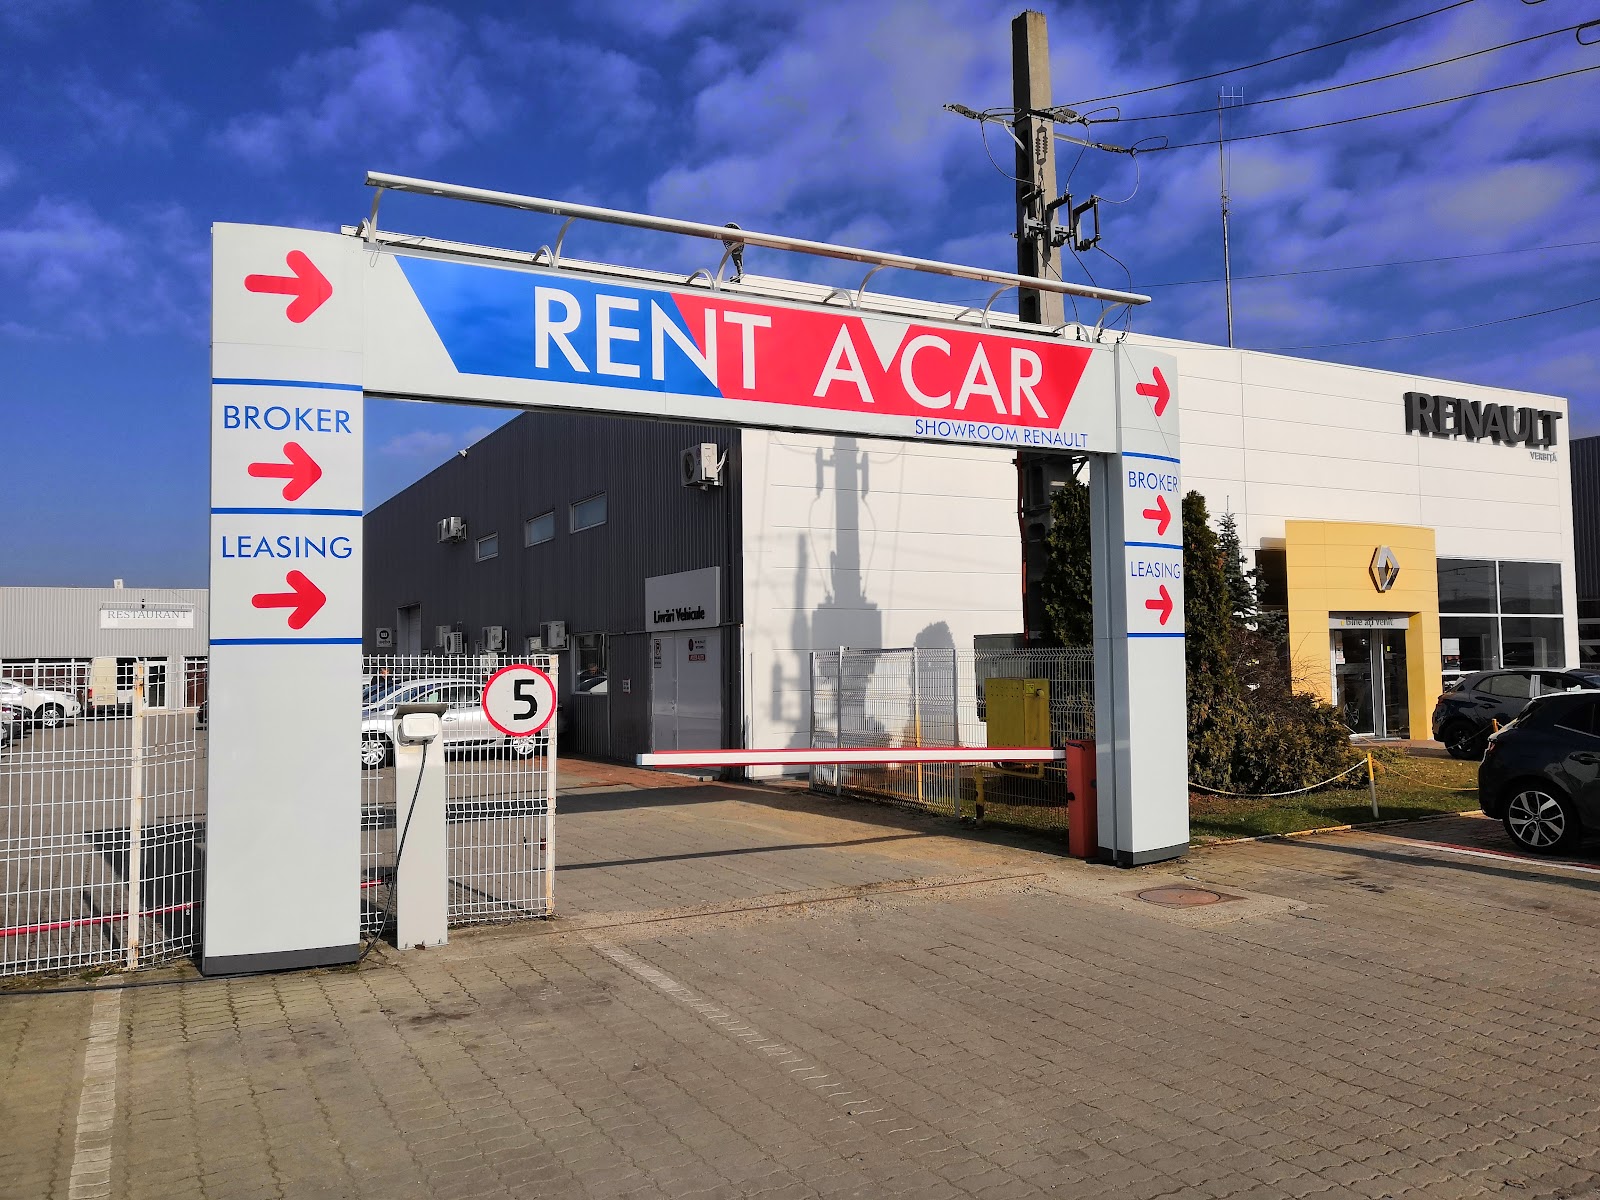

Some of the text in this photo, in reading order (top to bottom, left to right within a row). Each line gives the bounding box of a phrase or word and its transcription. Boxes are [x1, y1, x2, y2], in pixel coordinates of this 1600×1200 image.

[533, 286, 1049, 420] RENT A CAR
[223, 405, 352, 433] BROKER
[1403, 392, 1563, 450] RENAULT
[915, 419, 1088, 447] SHOWROOM RENAULT
[1128, 471, 1179, 493] BROKER
[222, 536, 352, 559] LEASING
[1130, 561, 1181, 579] LEASING
[107, 610, 187, 619] RESTAURANT
[675, 605, 705, 621] Vehicule
[513, 679, 538, 720] 5
